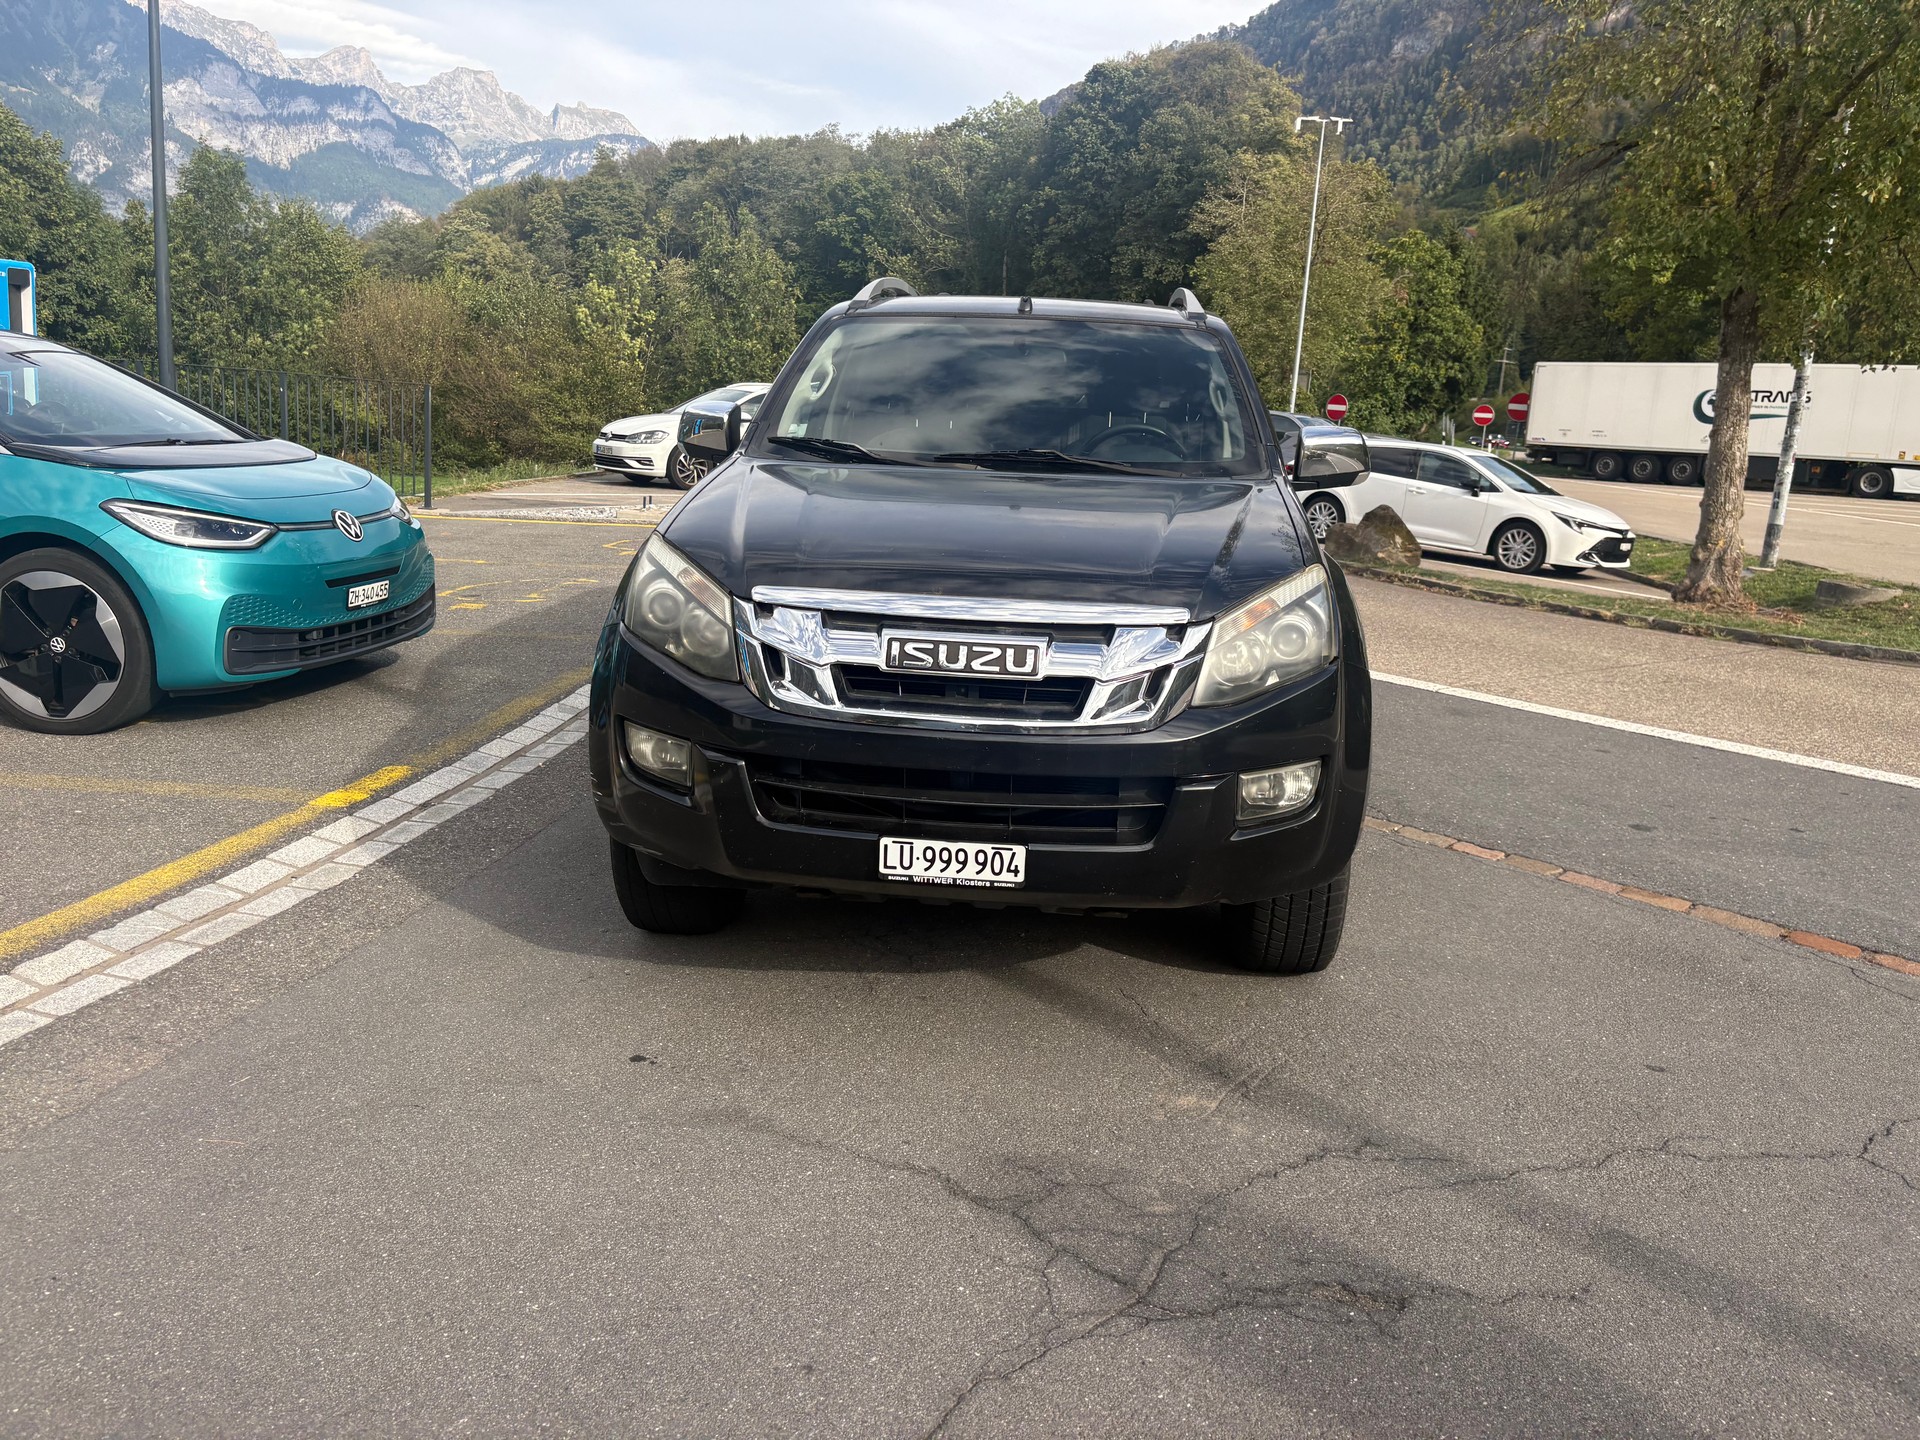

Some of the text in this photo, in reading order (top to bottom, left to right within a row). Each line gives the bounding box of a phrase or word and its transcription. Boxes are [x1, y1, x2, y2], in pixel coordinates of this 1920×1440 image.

[890, 640, 1036, 674] ISUZU
[913, 876, 953, 885] WITTWER
[956, 878, 991, 887] Klosters
